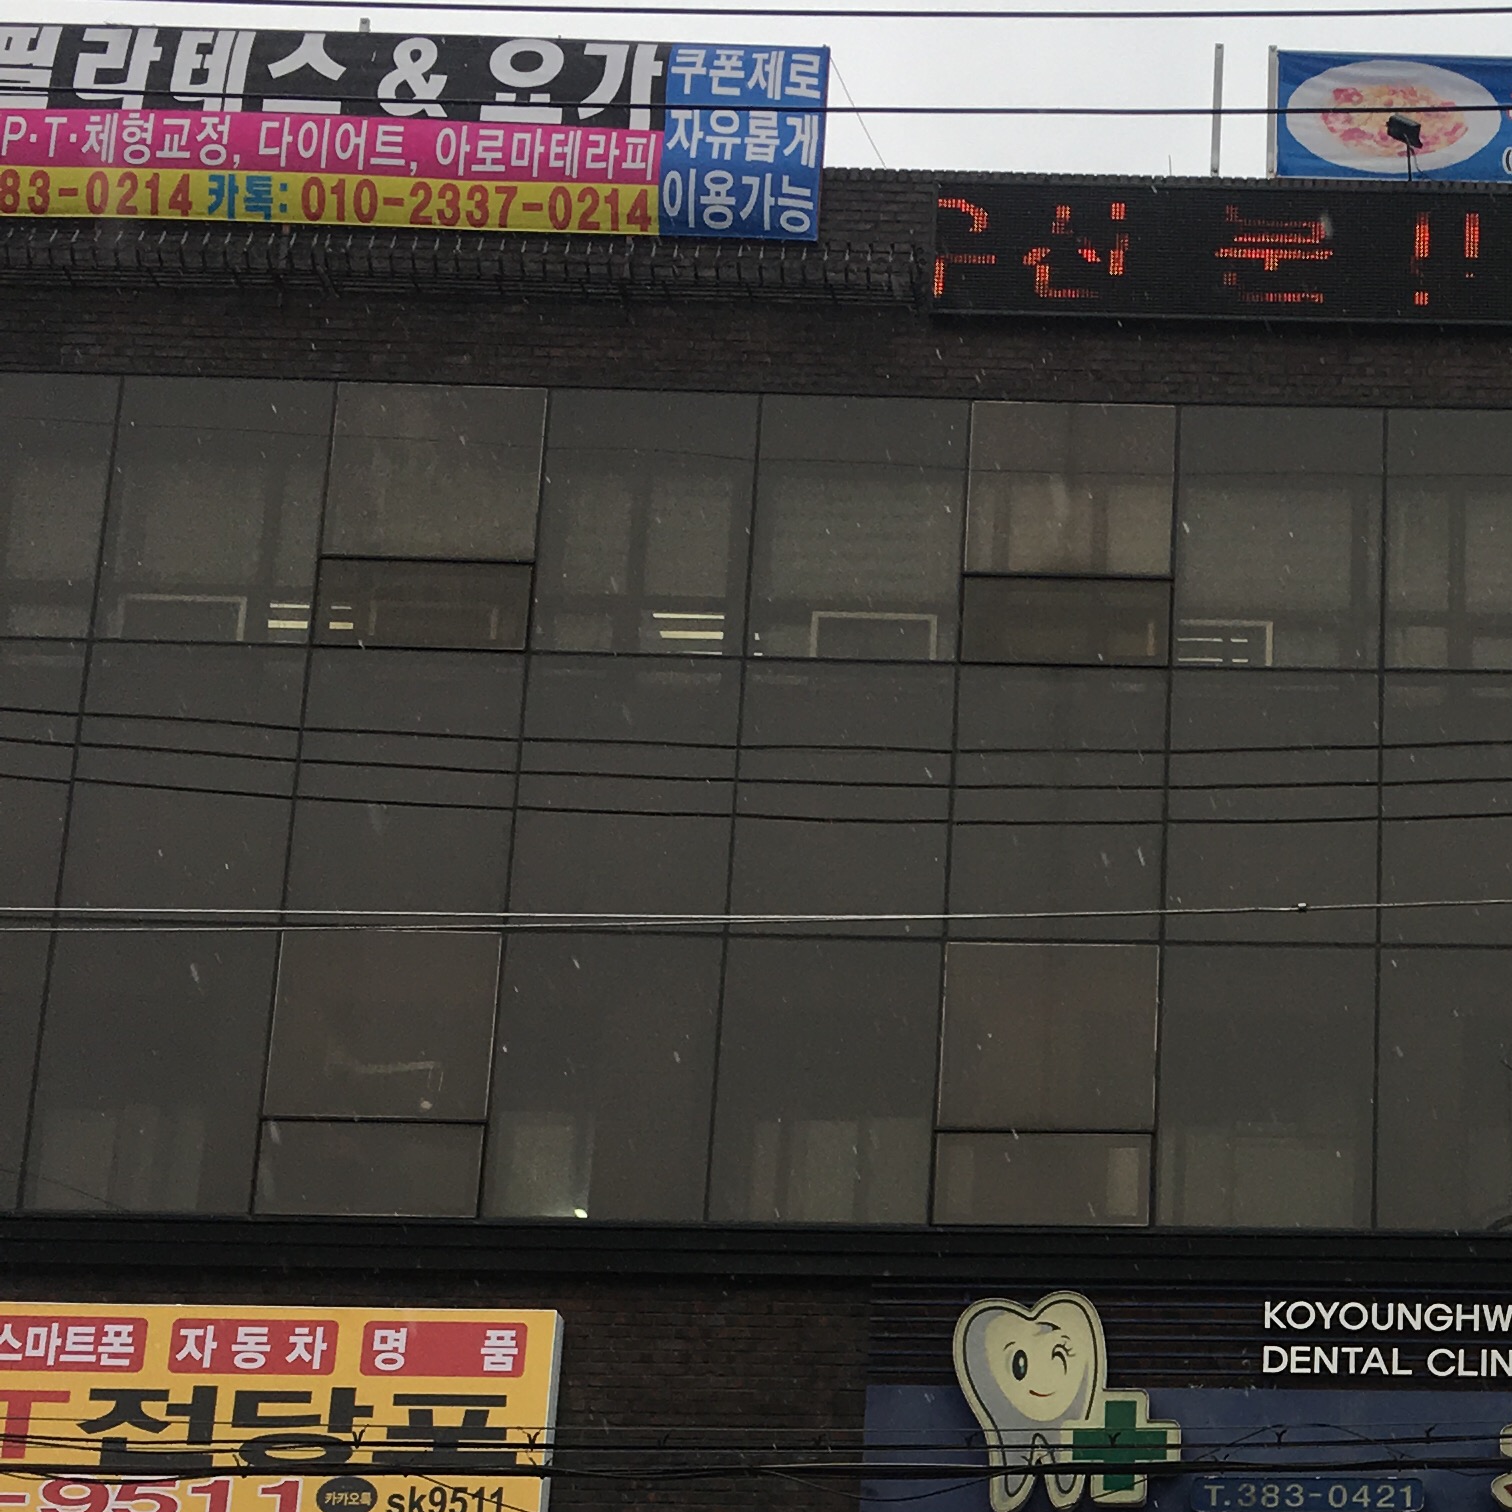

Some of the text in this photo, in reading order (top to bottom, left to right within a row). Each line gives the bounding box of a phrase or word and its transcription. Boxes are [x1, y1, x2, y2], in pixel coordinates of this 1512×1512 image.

[0, 26, 663, 130] 필라테스 & 요가
[671, 48, 821, 99] 쿠폰제로
[259, 118, 417, 175] 다이어트,
[436, 125, 656, 180] 아로마테라피
[666, 108, 820, 170] 자유롭게
[208, 174, 288, 220] 카톡:
[302, 177, 651, 231] 010-2337-0214
[664, 169, 814, 233] 이용가능
[0, 1323, 137, 1367] 스마트폰
[175, 1324, 328, 1370] 자동차
[1262, 1346, 1412, 1376] DENTAL
